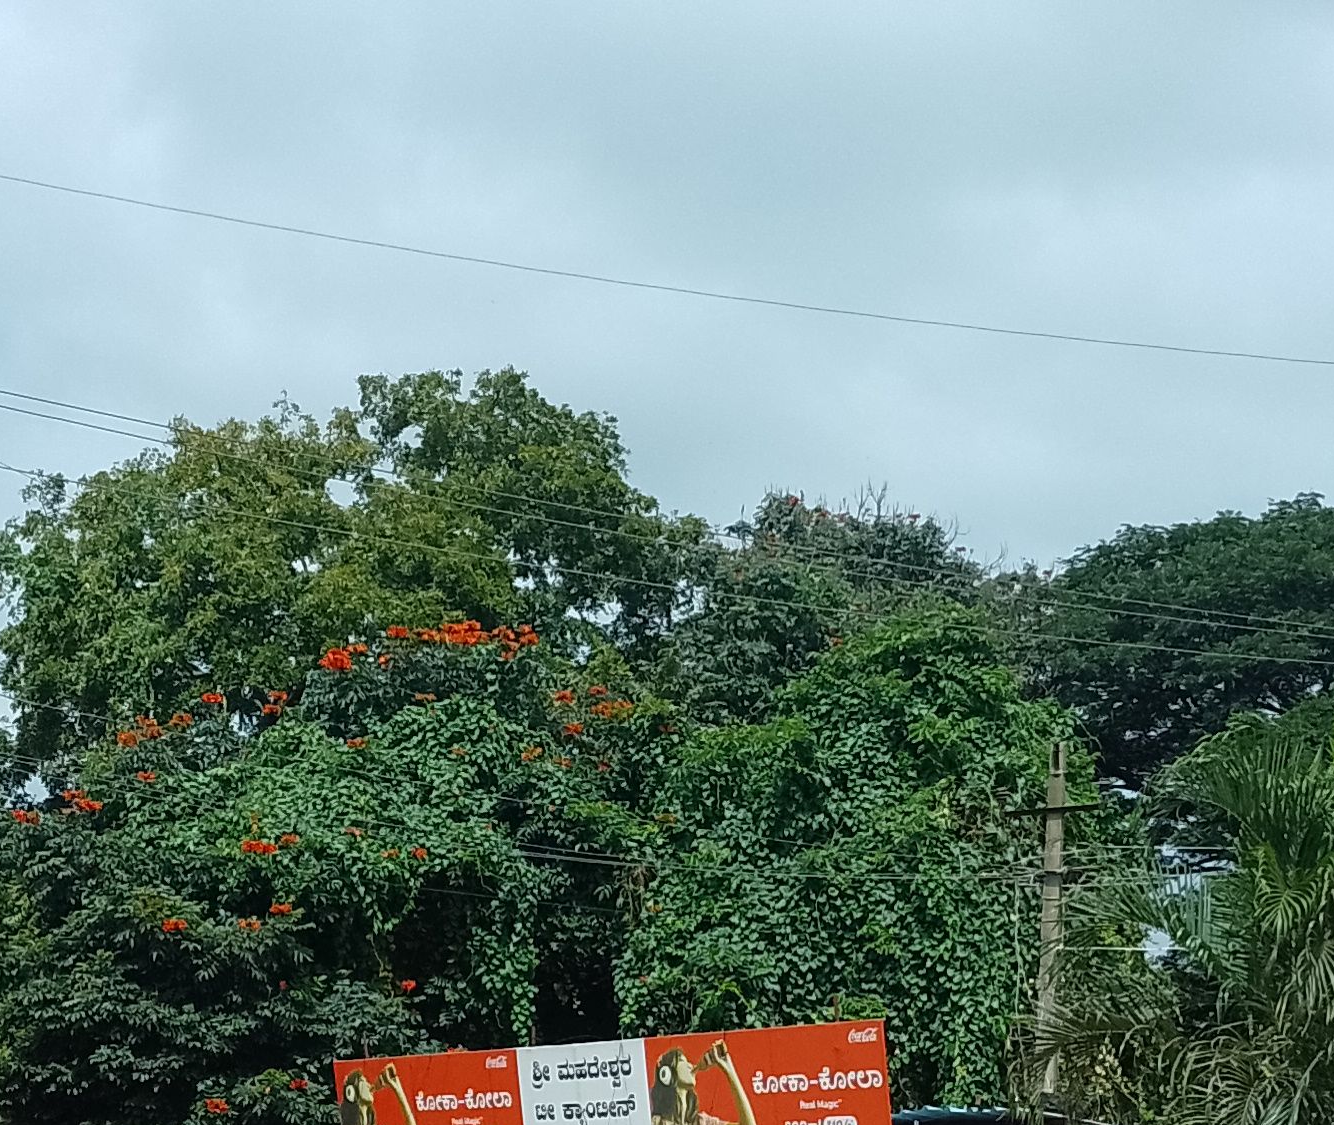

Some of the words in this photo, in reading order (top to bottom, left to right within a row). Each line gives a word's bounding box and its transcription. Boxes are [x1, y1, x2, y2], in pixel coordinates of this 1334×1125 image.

[532, 1060, 551, 1089] ಶ್ರೀ
[557, 1054, 632, 1089] ಮಹದೇಶ್ವರ
[751, 1066, 884, 1095] ಕೋಕಾ-ಕೋಲಾ
[415, 1087, 512, 1112] ಕೋಕಾ-ಕೋಲಾ
[535, 1103, 556, 1121] ಟೀ
